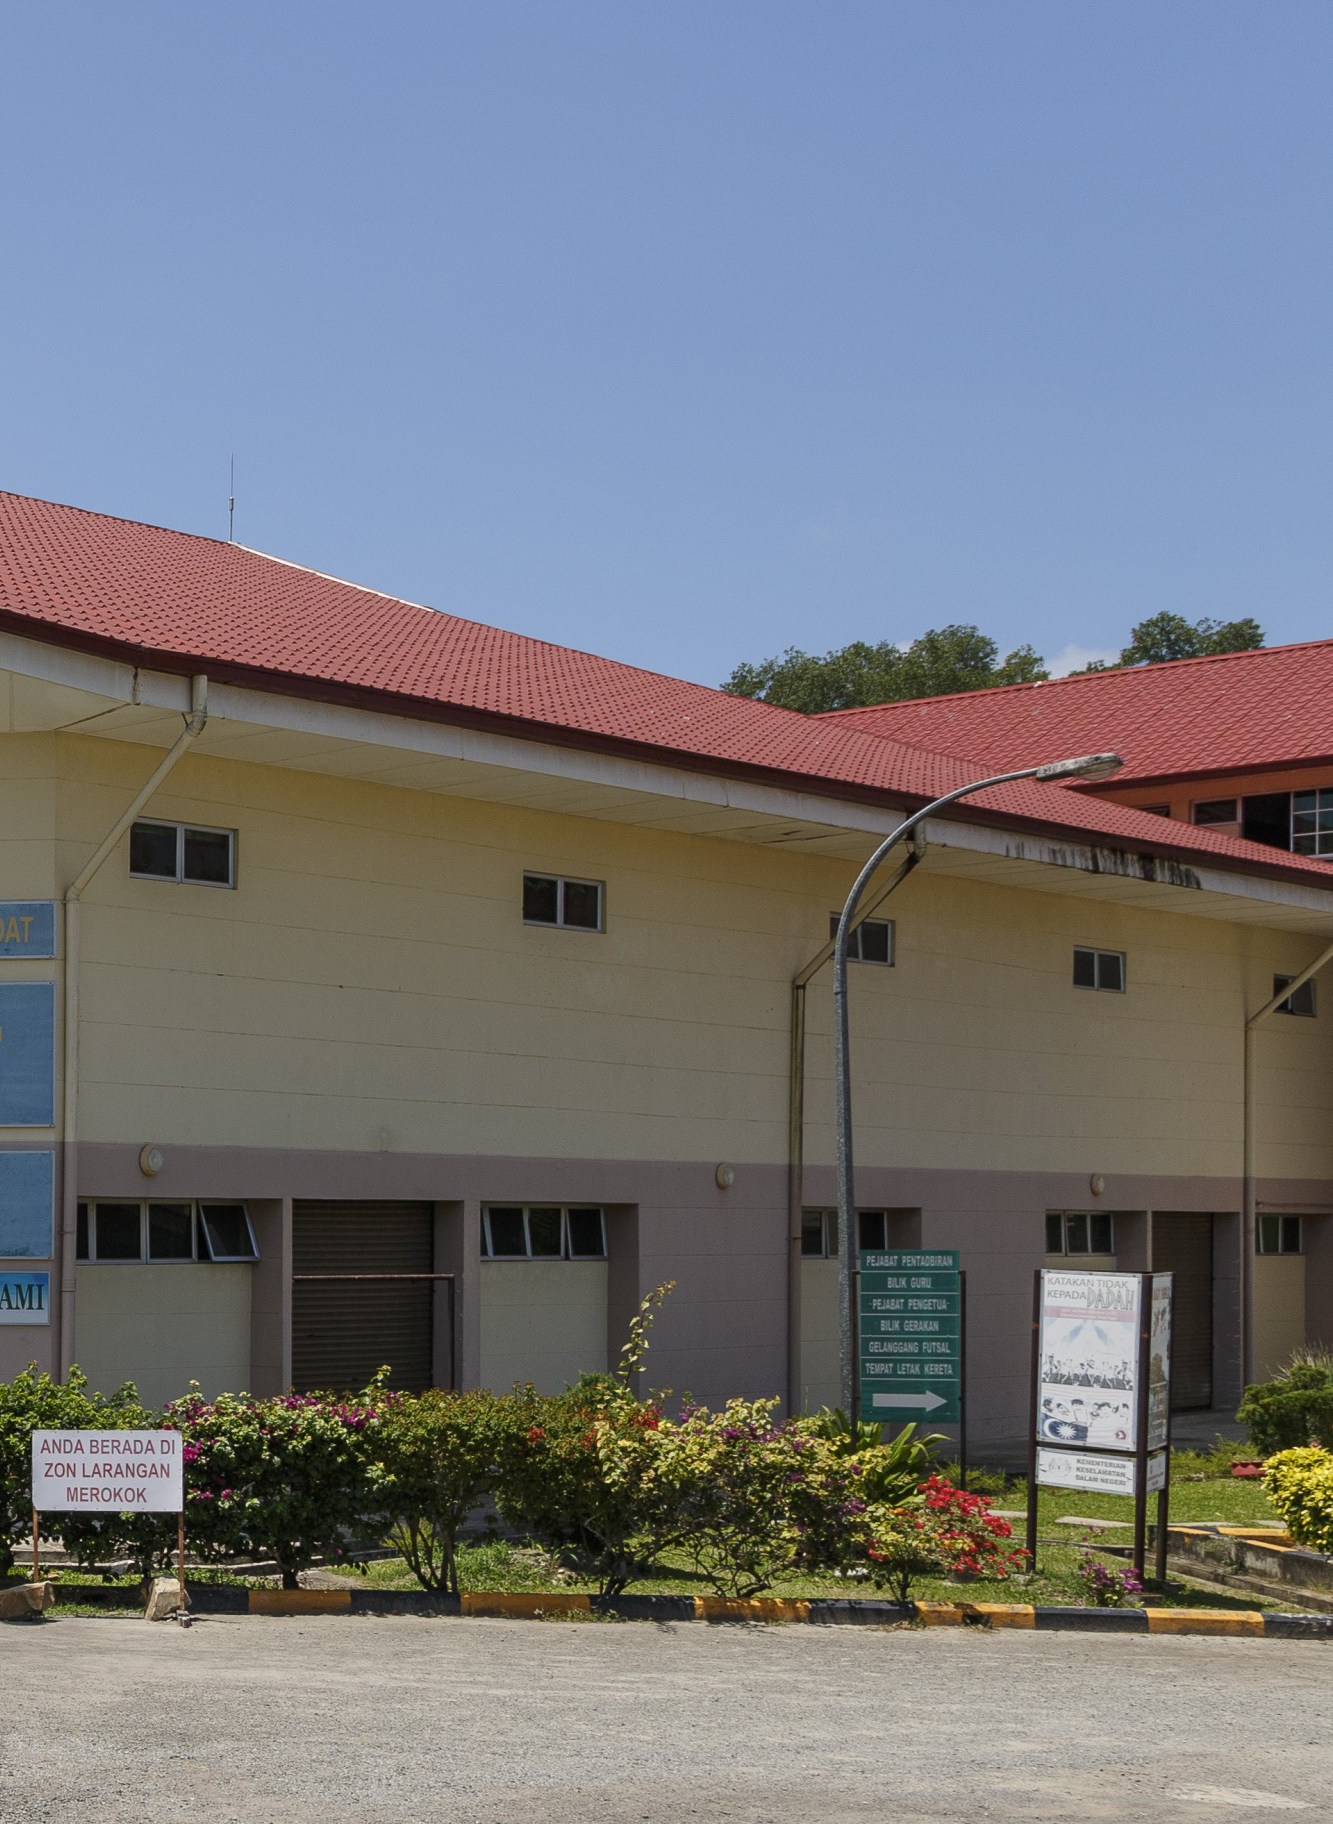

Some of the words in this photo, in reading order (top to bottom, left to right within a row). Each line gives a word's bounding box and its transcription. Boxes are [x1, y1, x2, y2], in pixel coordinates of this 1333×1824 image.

[866, 1255, 898, 1267] PEJABAT
[901, 1255, 953, 1267] PENTADBIRAN
[887, 1277, 907, 1288] BILIK
[1047, 1277, 1094, 1287] KATAKAN
[1095, 1279, 1129, 1289] TIDAK
[1047, 1289, 1087, 1300] KEPADA
[1087, 1287, 1135, 1311] DADAH
[880, 1320, 900, 1331] BILIK
[904, 1320, 939, 1331] GERAKAN
[868, 1341, 919, 1353] GELANGGANG
[922, 1342, 950, 1353] FUTSAL
[865, 1363, 893, 1374] TEMPAT
[897, 1363, 920, 1375] LETAK
[924, 1364, 953, 1375] KERETA
[40, 1439, 85, 1454] ANDA
[89, 1439, 155, 1454] BERADA
[160, 1439, 175, 1455] DI
[1076, 1458, 1126, 1469] KEMENTERIAN
[44, 1462, 76, 1478] ZON
[82, 1462, 170, 1479] LARANGAN
[1076, 1466, 1126, 1478] KESELAMATAN
[1075, 1474, 1098, 1483] DALAM
[1100, 1477, 1126, 1486] NEGERI
[66, 1487, 147, 1503] MEROKOK
